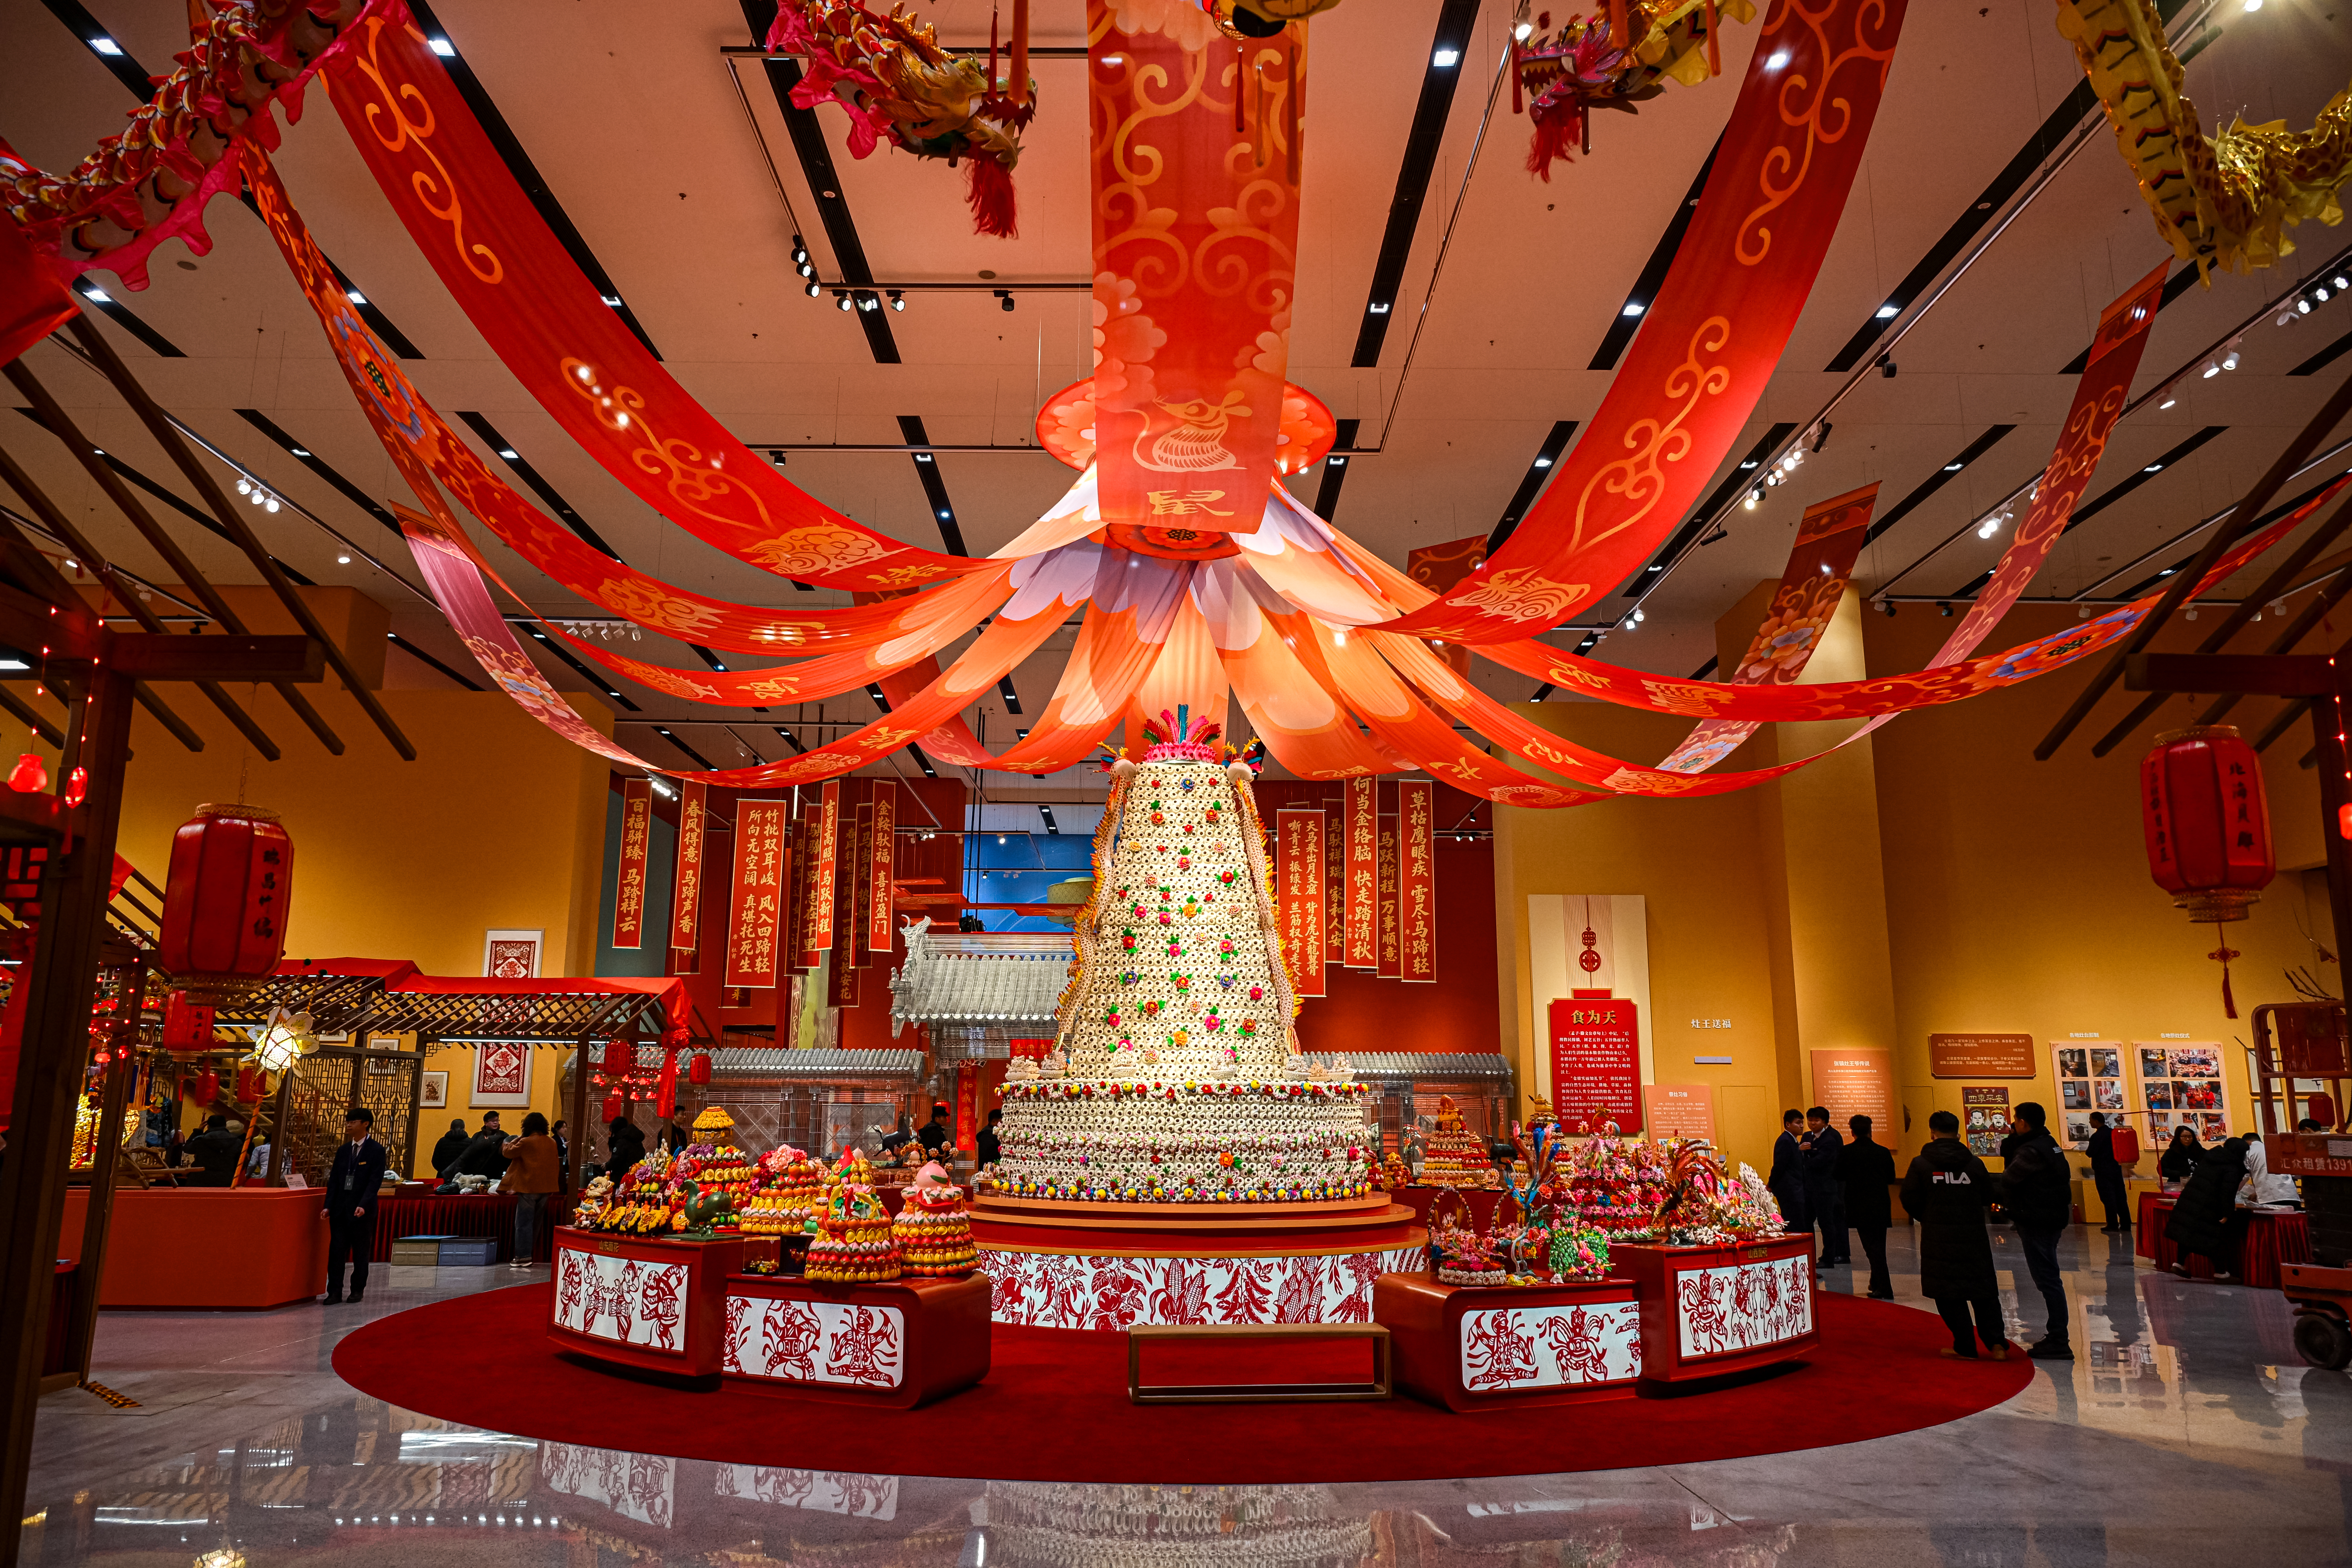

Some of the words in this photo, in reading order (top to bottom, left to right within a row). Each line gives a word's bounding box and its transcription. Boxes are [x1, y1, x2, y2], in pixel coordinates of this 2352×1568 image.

[1147, 490, 1234, 516] 鼠
[625, 799, 647, 861] 百福骈臻
[683, 799, 702, 863] 春风得意
[744, 810, 761, 887] 所向无空阔
[760, 809, 779, 887] 竹批双耳峻
[822, 799, 835, 864] 吉星高照
[876, 799, 892, 864] 金鞍驮福
[1287, 820, 1301, 856] 嘶青云
[1328, 818, 1344, 878] 马驮祥瑞
[1353, 775, 1374, 862] 何当金络脑
[1410, 790, 1430, 877] 草枯鹰眼疾
[859, 822, 873, 881] 一马当先
[1289, 861, 1302, 895] 振绿发
[1305, 820, 1319, 895] 天马来出月支窟
[1378, 831, 1397, 893] 马跃新程
[619, 868, 641, 932] 马踏祥云
[679, 869, 696, 933] 马蹄声香
[802, 890, 818, 952] 志在千里
[819, 869, 832, 935] 马跃新程
[855, 888, 870, 952] 势如破竹
[875, 871, 889, 935] 喜乐盈门
[1328, 886, 1345, 948] 家和人安
[1352, 869, 1374, 960] 快走踏清秋
[1381, 900, 1397, 962] 万事顺意
[1411, 884, 1430, 975] 雪尽马蹄轻
[738, 894, 757, 973] 真堪托死生
[754, 894, 775, 974] 风入四蹄轻
[1571, 1010, 1616, 1024] 食为天
[1691, 1019, 1731, 1029] 灶王送福
[1969, 1094, 2004, 1103] 四季平安
[1933, 1172, 1971, 1183] FILA
